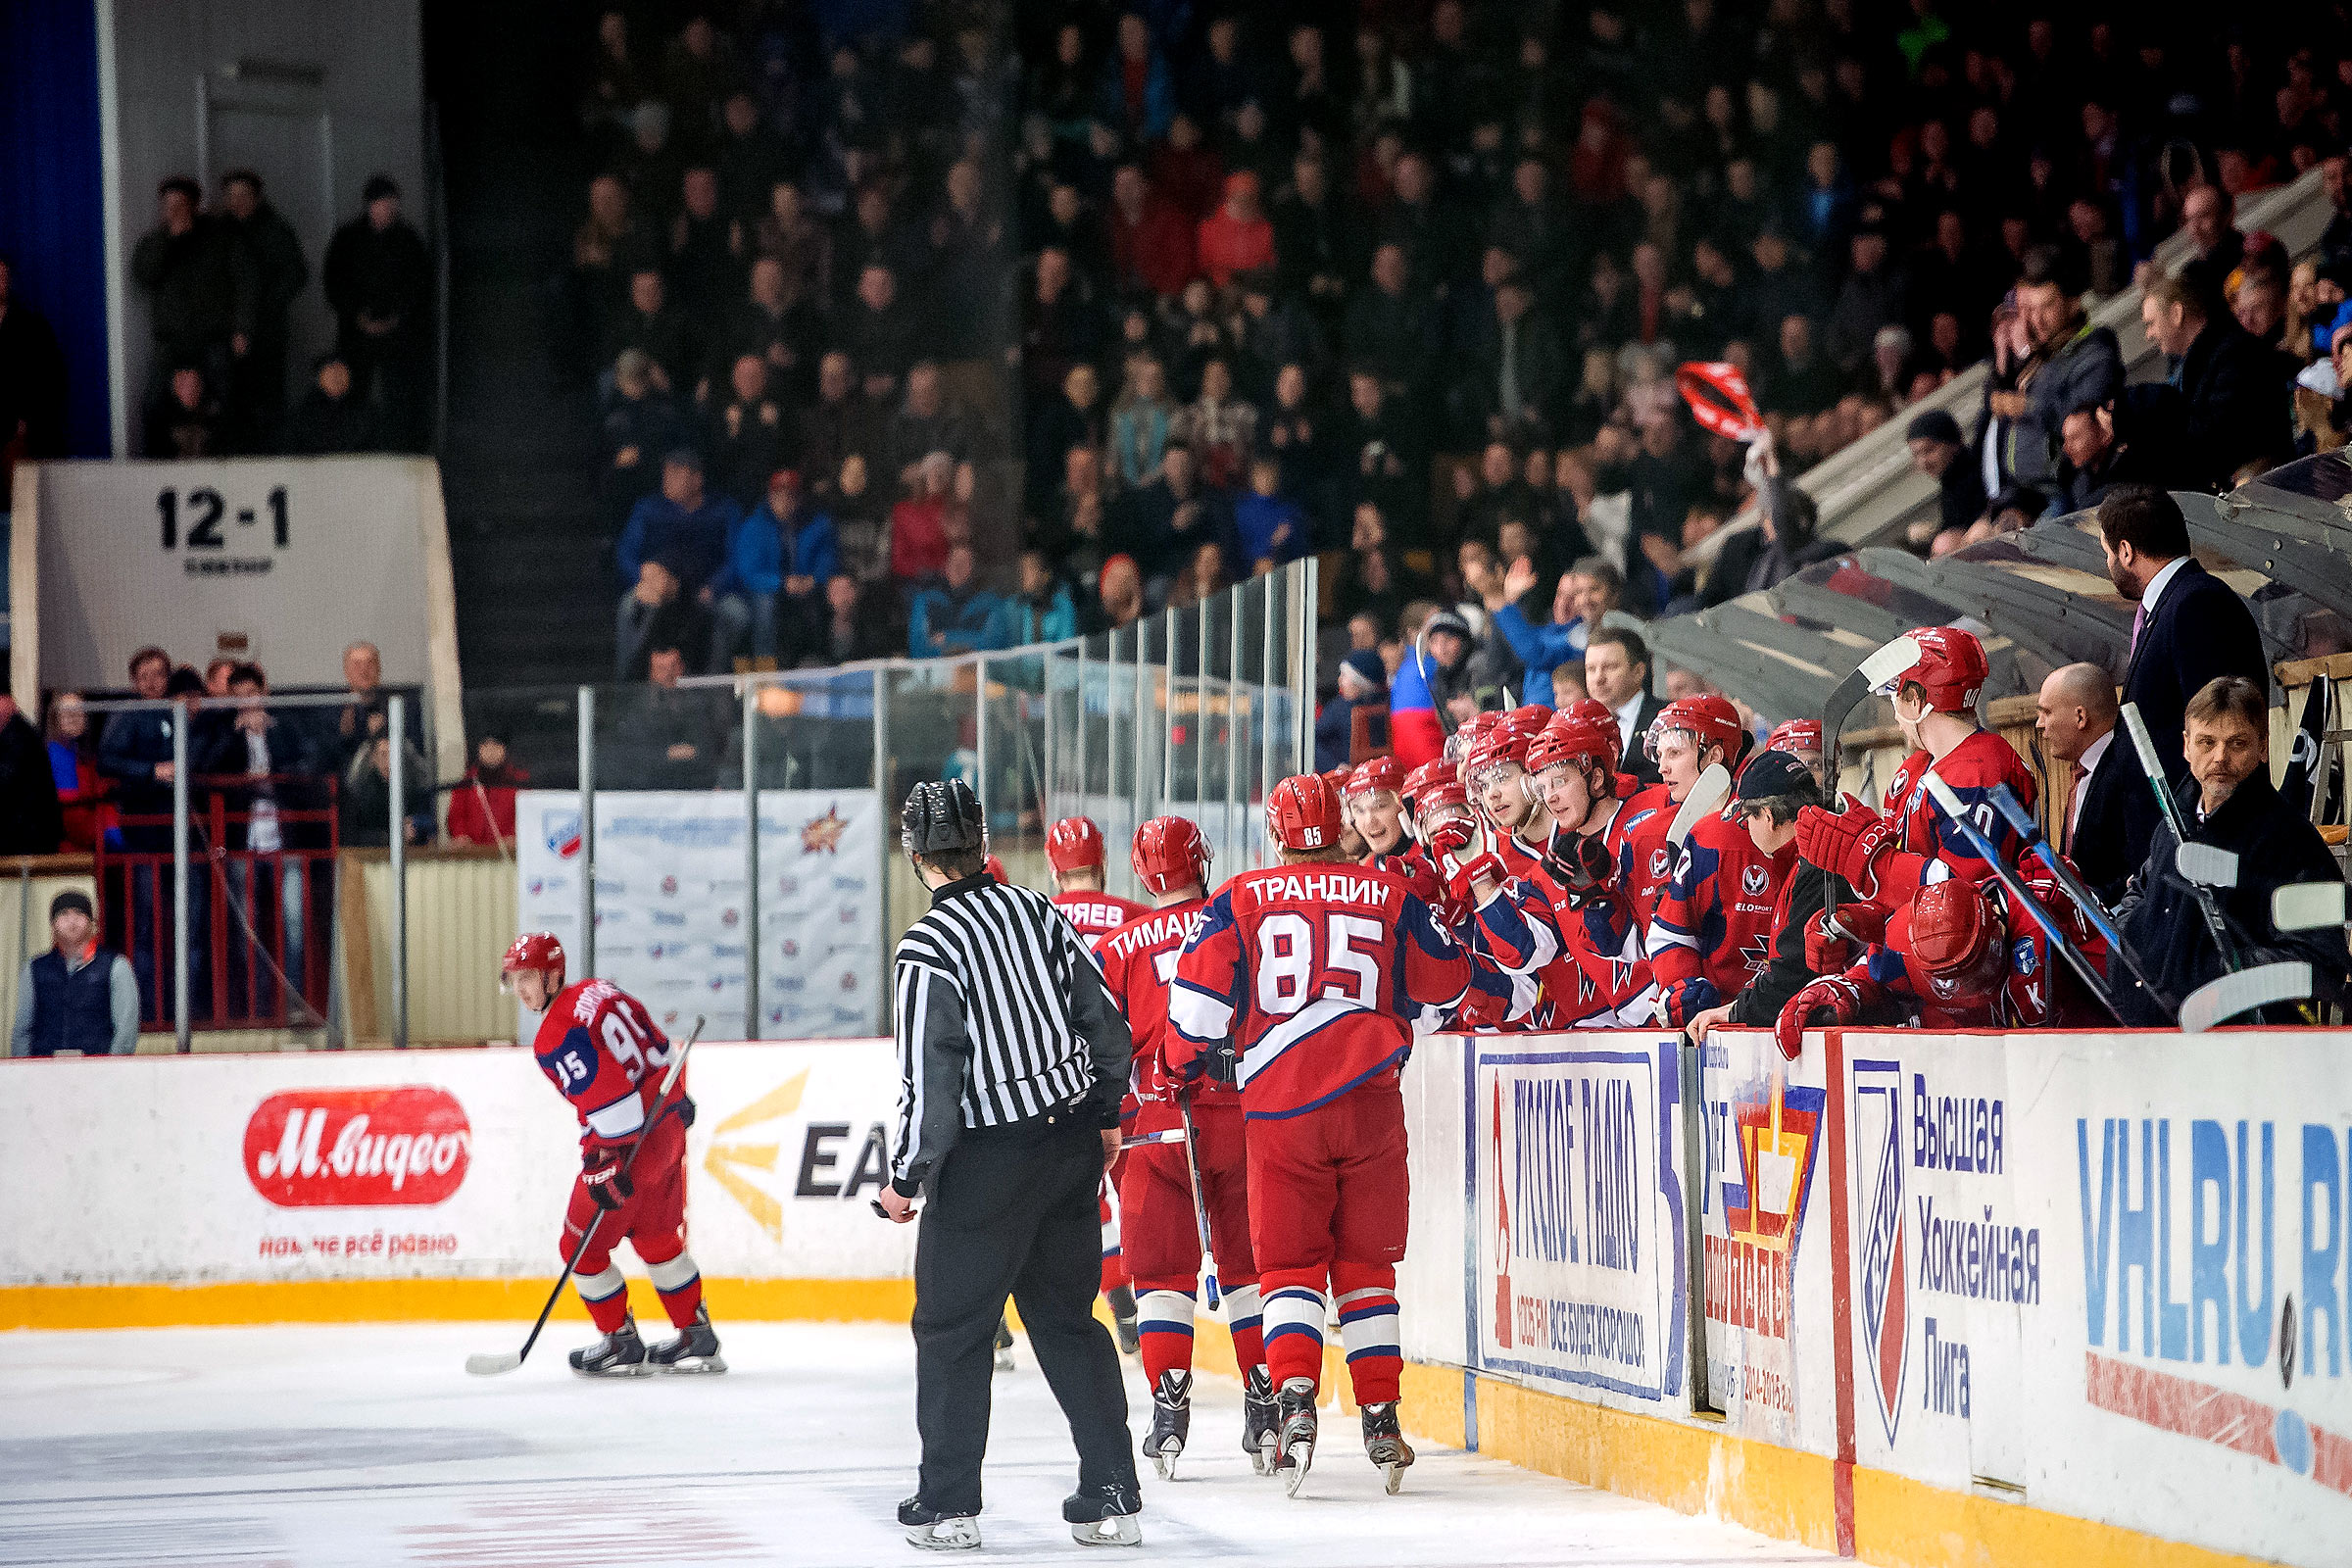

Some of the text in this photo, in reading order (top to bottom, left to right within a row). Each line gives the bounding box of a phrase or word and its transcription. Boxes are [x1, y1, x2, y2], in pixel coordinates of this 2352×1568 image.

[156, 484, 291, 550] 12-1
[1303, 826, 1322, 847] 85
[1055, 902, 1124, 928] ЛЯЕВ
[1247, 874, 1390, 906] ТРАНДИН
[1735, 902, 1773, 913] ELOSPORT
[1256, 912, 1384, 1016] 85
[258, 1107, 468, 1192] М.видео
[795, 1120, 891, 1197] EA
[1914, 1073, 2004, 1175] Высшая
[1514, 1078, 1639, 1274] РУССКОЕ РАДИО
[1918, 1196, 2040, 1305] Хоккейная
[2077, 1117, 2352, 1382] VHLRU.R
[1568, 1300, 1596, 1367] БУДЕТ
[1596, 1304, 1646, 1369] ХОРОШО!
[1924, 1317, 1971, 1419] Лига
